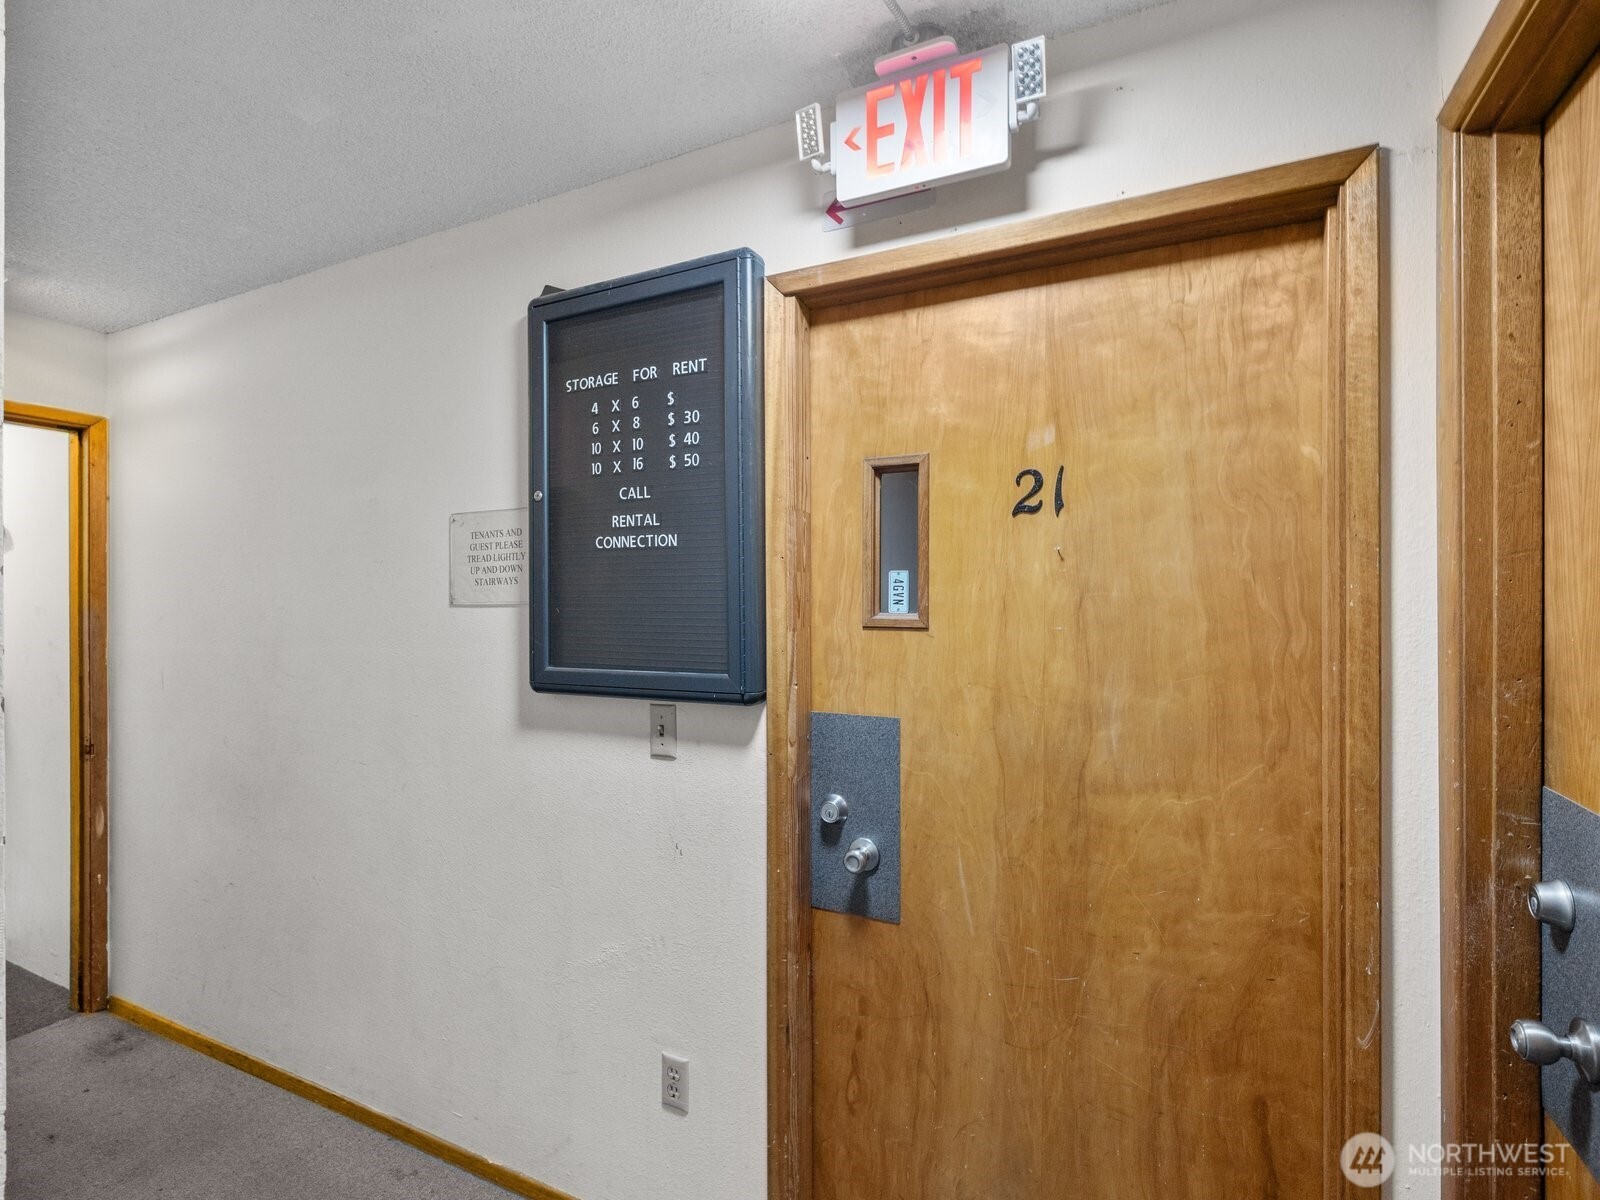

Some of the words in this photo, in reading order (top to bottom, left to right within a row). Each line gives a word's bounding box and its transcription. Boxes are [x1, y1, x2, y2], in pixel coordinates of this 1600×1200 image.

[865, 57, 983, 181] EXIT
[565, 372, 619, 393] STORAGE
[632, 366, 658, 382] FOR
[672, 358, 708, 376] RENT
[591, 402, 599, 415] 4
[611, 399, 620, 412] X
[631, 396, 639, 409] 6
[667, 391, 675, 406] $
[592, 422, 599, 435] 6
[611, 419, 620, 433] X
[632, 416, 640, 430] 8
[591, 442, 602, 455] 10
[612, 440, 621, 453] X
[632, 438, 644, 451] 10
[591, 462, 602, 475] 10
[613, 460, 621, 474] X
[632, 457, 644, 470] 16
[619, 486, 651, 500] CALL
[1011, 465, 1065, 518] 21
[612, 513, 660, 528] RENTAL
[470, 529, 504, 540] TENANTS
[505, 527, 523, 538] AND
[595, 533, 678, 549] CONNECTION
[469, 541, 494, 552] GUEST
[495, 539, 524, 550] PLEASE
[467, 553, 492, 563] TREAD
[493, 551, 526, 562] LIGHTLY
[470, 566, 480, 575] UP
[481, 565, 498, 574] AND
[499, 564, 523, 574] DOWN
[474, 576, 519, 587] STAIRWAYS
